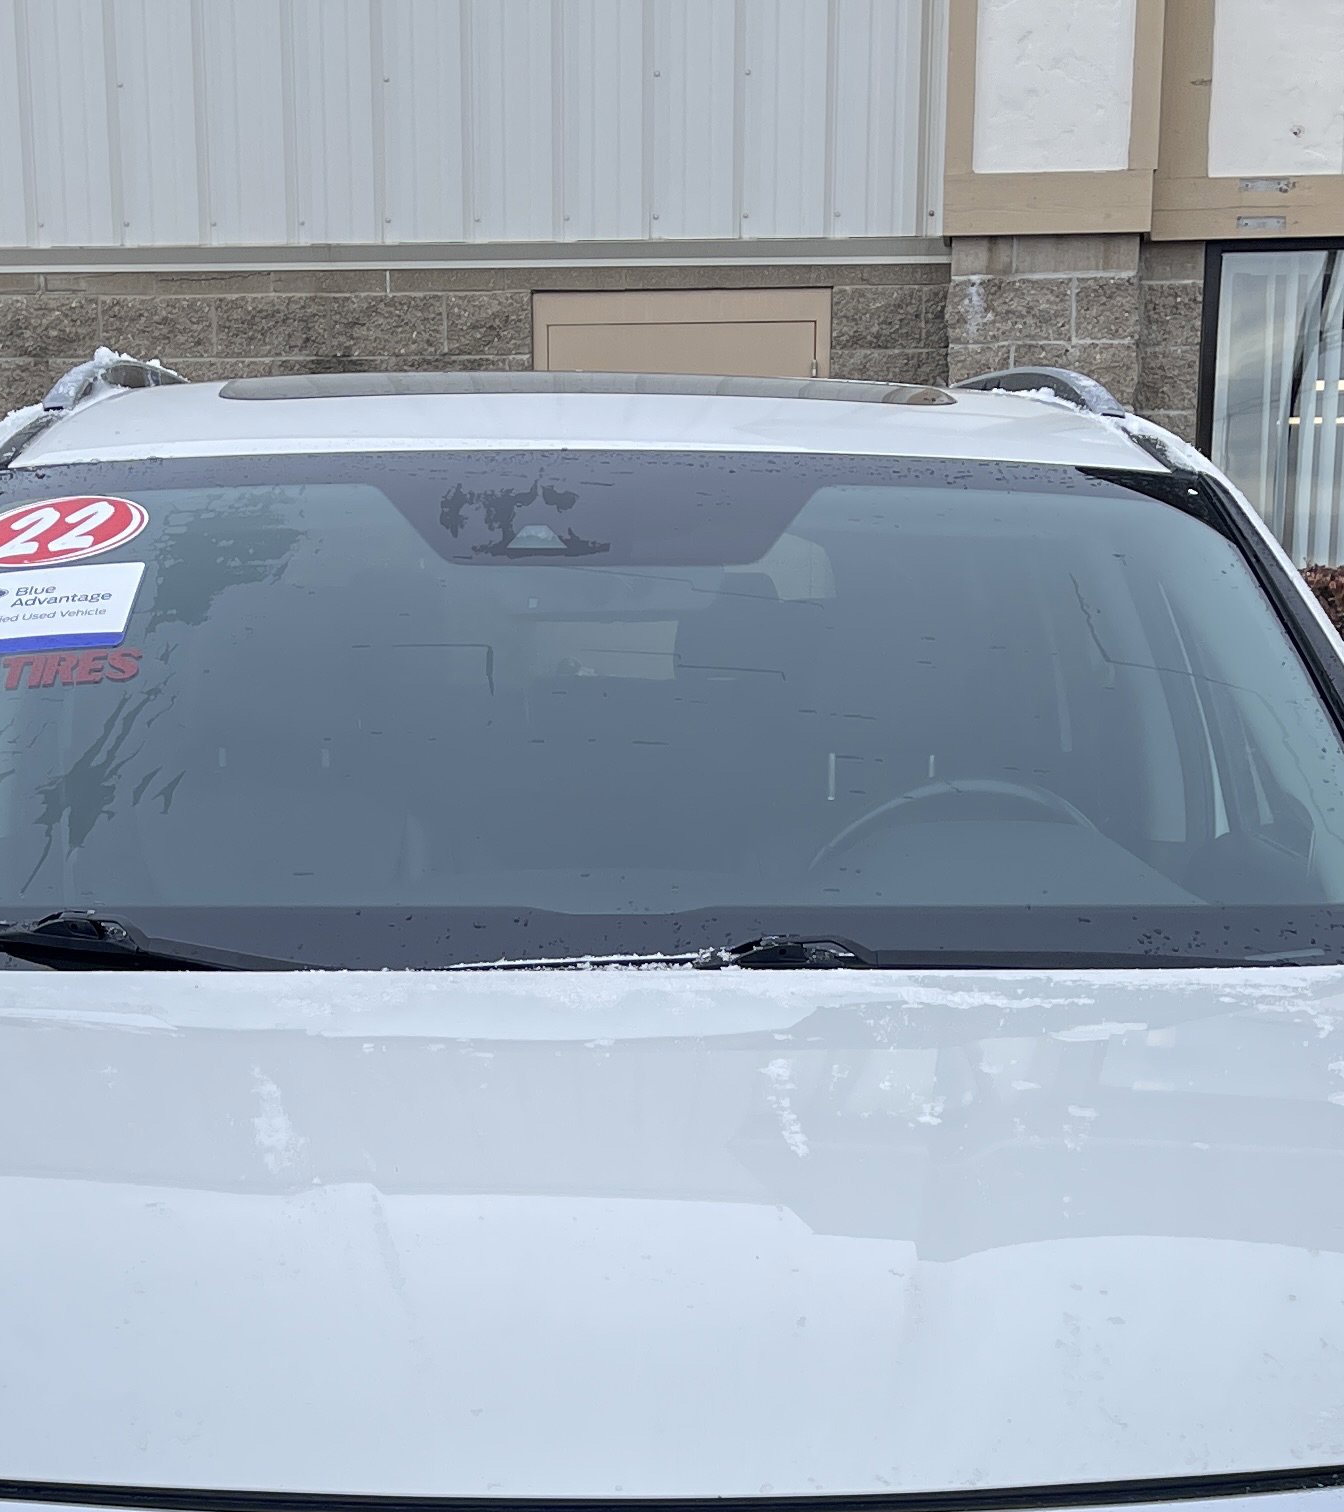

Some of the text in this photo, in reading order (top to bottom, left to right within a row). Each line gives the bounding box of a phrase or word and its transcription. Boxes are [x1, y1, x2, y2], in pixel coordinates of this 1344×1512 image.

[15, 585, 56, 597] Blue
[10, 592, 113, 608] Advantage
[22, 611, 56, 621] Used
[60, 608, 107, 618] Vehicle
[2, 647, 143, 690] TIRES
